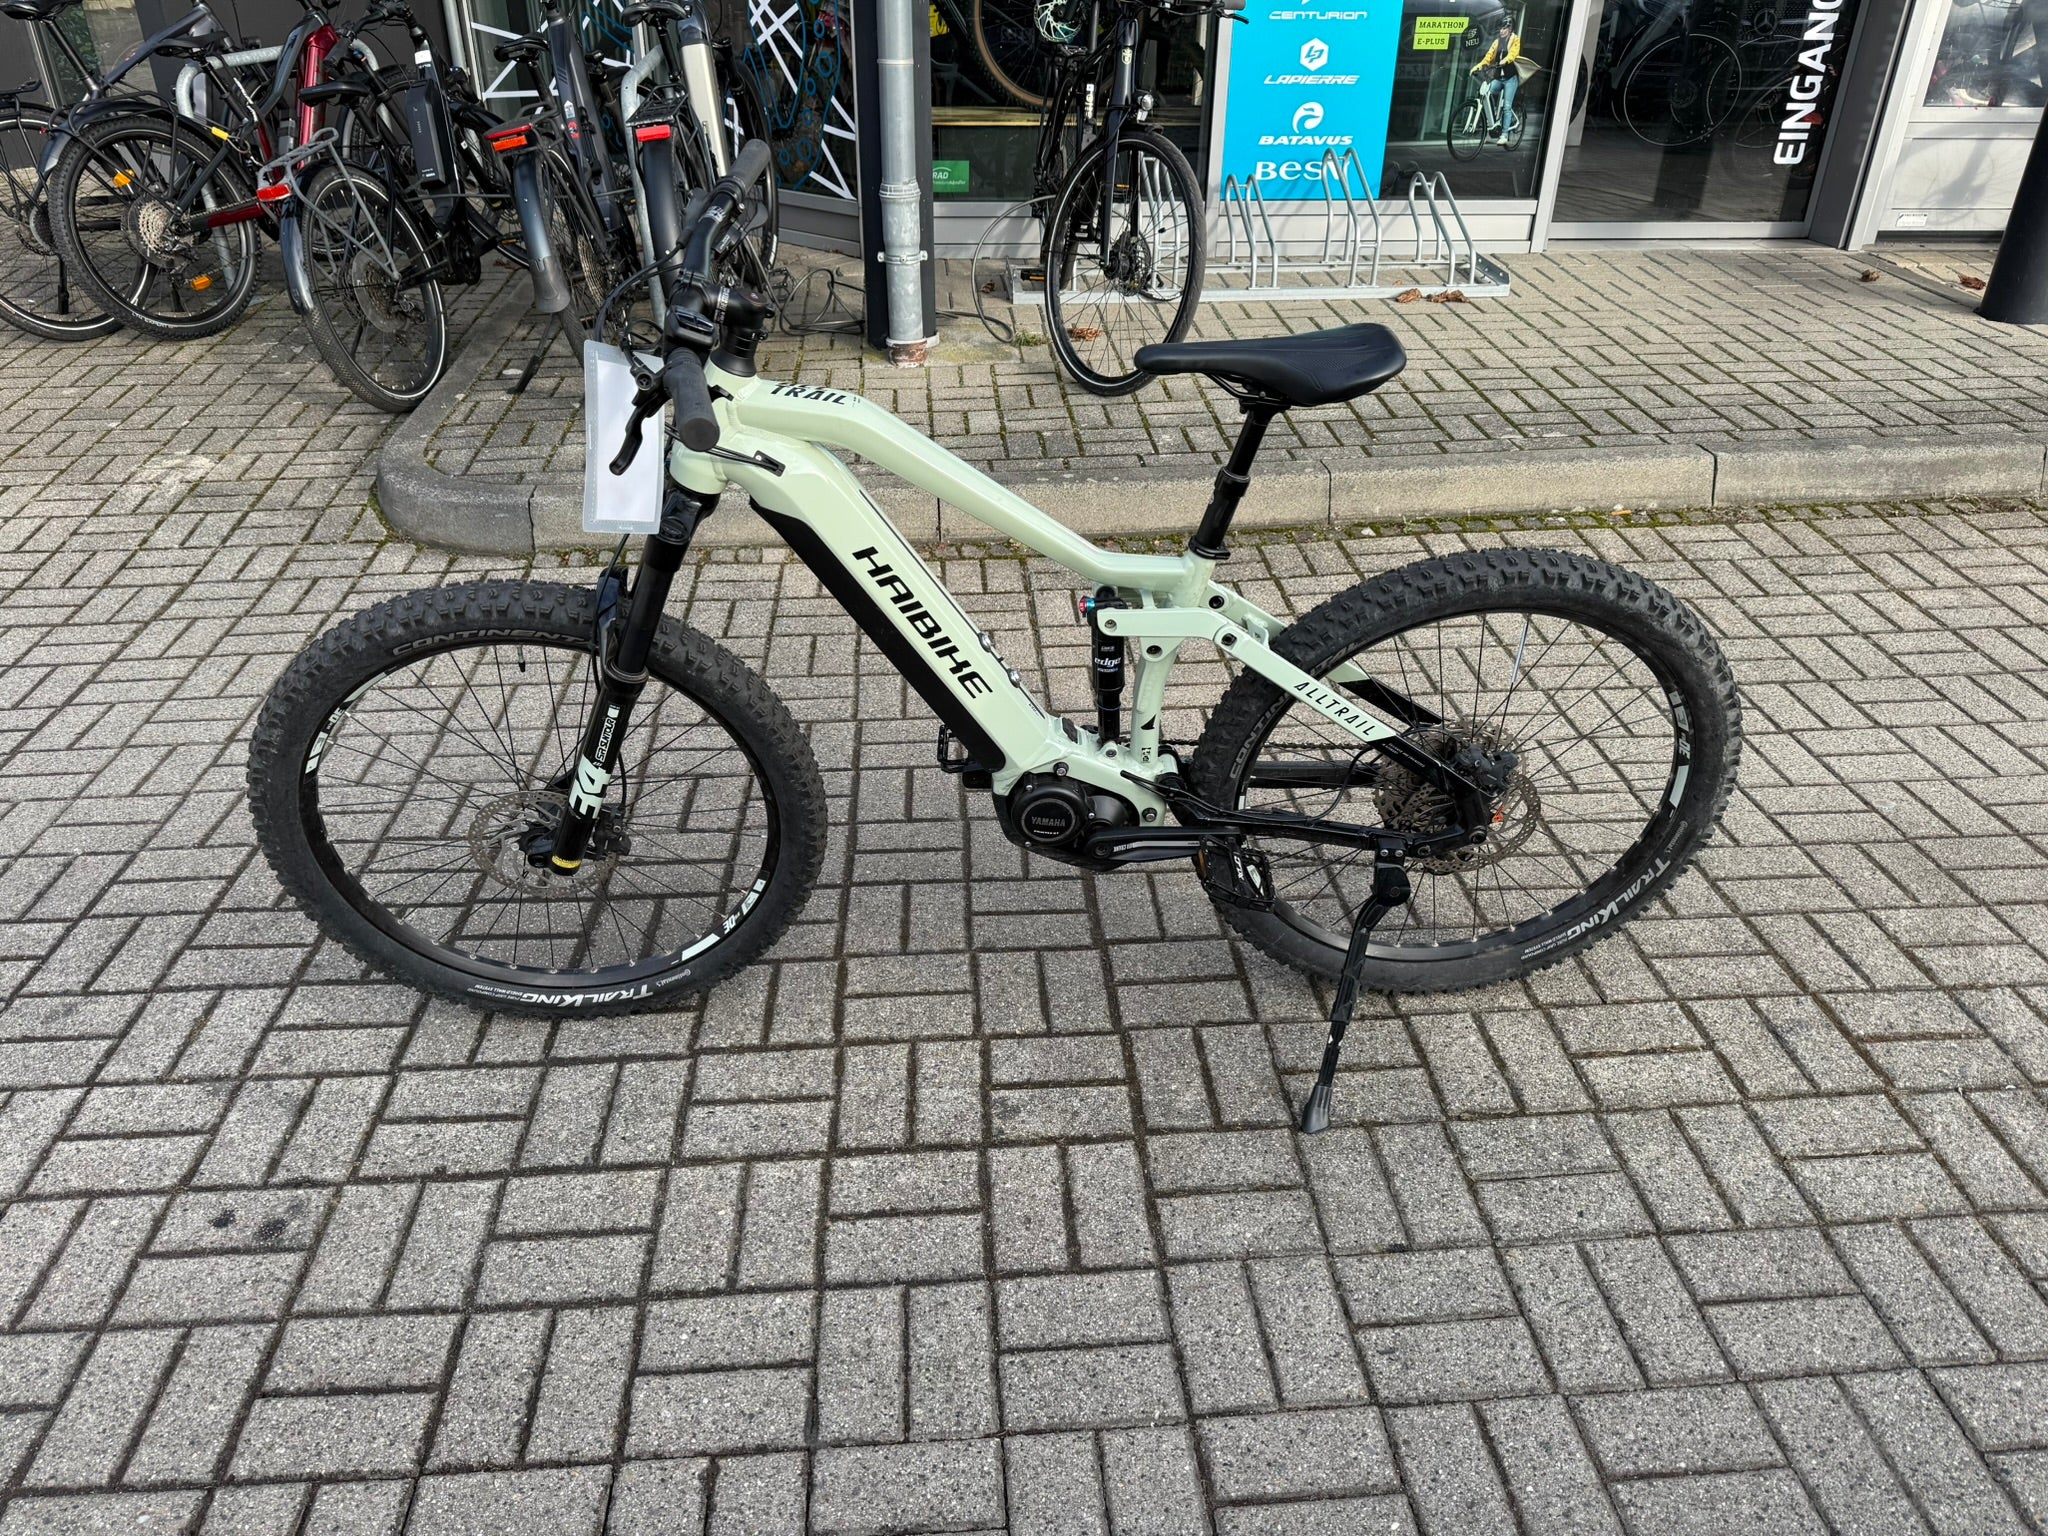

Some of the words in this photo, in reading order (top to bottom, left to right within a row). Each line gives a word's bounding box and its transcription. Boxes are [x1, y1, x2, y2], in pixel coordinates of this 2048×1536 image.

[1269, 11, 1368, 20] CENTURION
[1419, 21, 1465, 29] MARATHON
[1263, 75, 1361, 85] LAPIERRE
[1258, 135, 1354, 145] BATAVUS
[770, 385, 847, 405] TRAIL
[852, 546, 994, 699] HAIBIKE
[392, 629, 597, 656] CONTINENT
[1094, 657, 1122, 668] edge
[1293, 681, 1377, 736] ALLTRAIL
[568, 755, 612, 820] 34
[1031, 816, 1066, 828] YAMAHA
